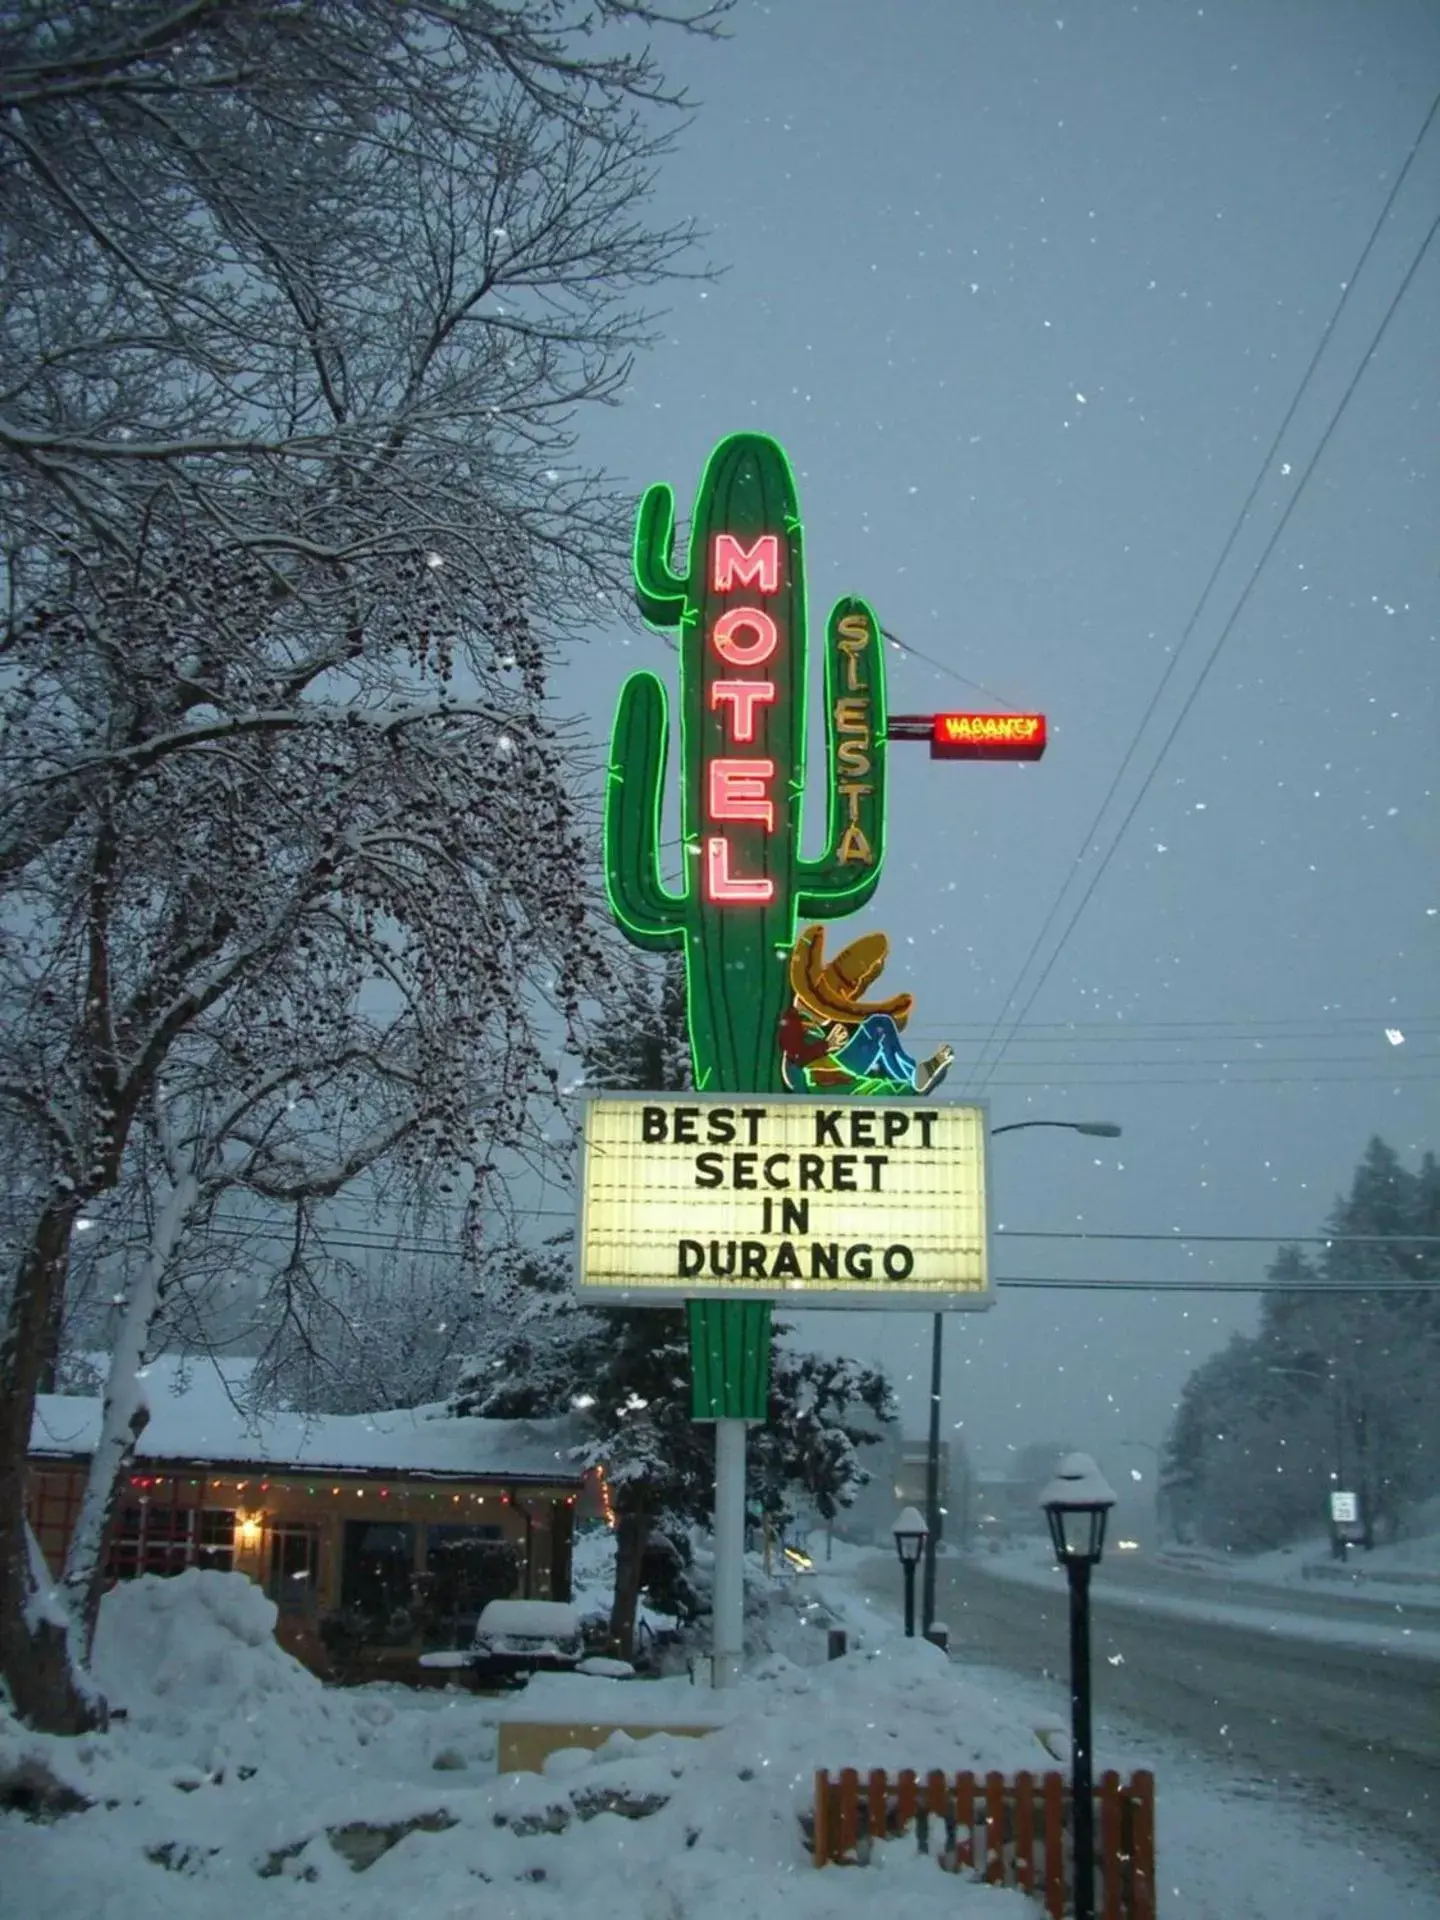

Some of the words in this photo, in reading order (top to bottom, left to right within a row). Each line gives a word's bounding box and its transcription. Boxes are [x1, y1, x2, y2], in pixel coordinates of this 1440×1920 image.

[708, 534, 779, 902] MOTEL
[945, 717, 1038, 740] VACANCY
[834, 615, 874, 866] SIESTA
[642, 1107, 766, 1144] BEST
[815, 1110, 938, 1147] KEPT
[694, 1153, 889, 1191] SECRET
[763, 1197, 809, 1234] IN
[678, 1240, 914, 1280] DURANGO
